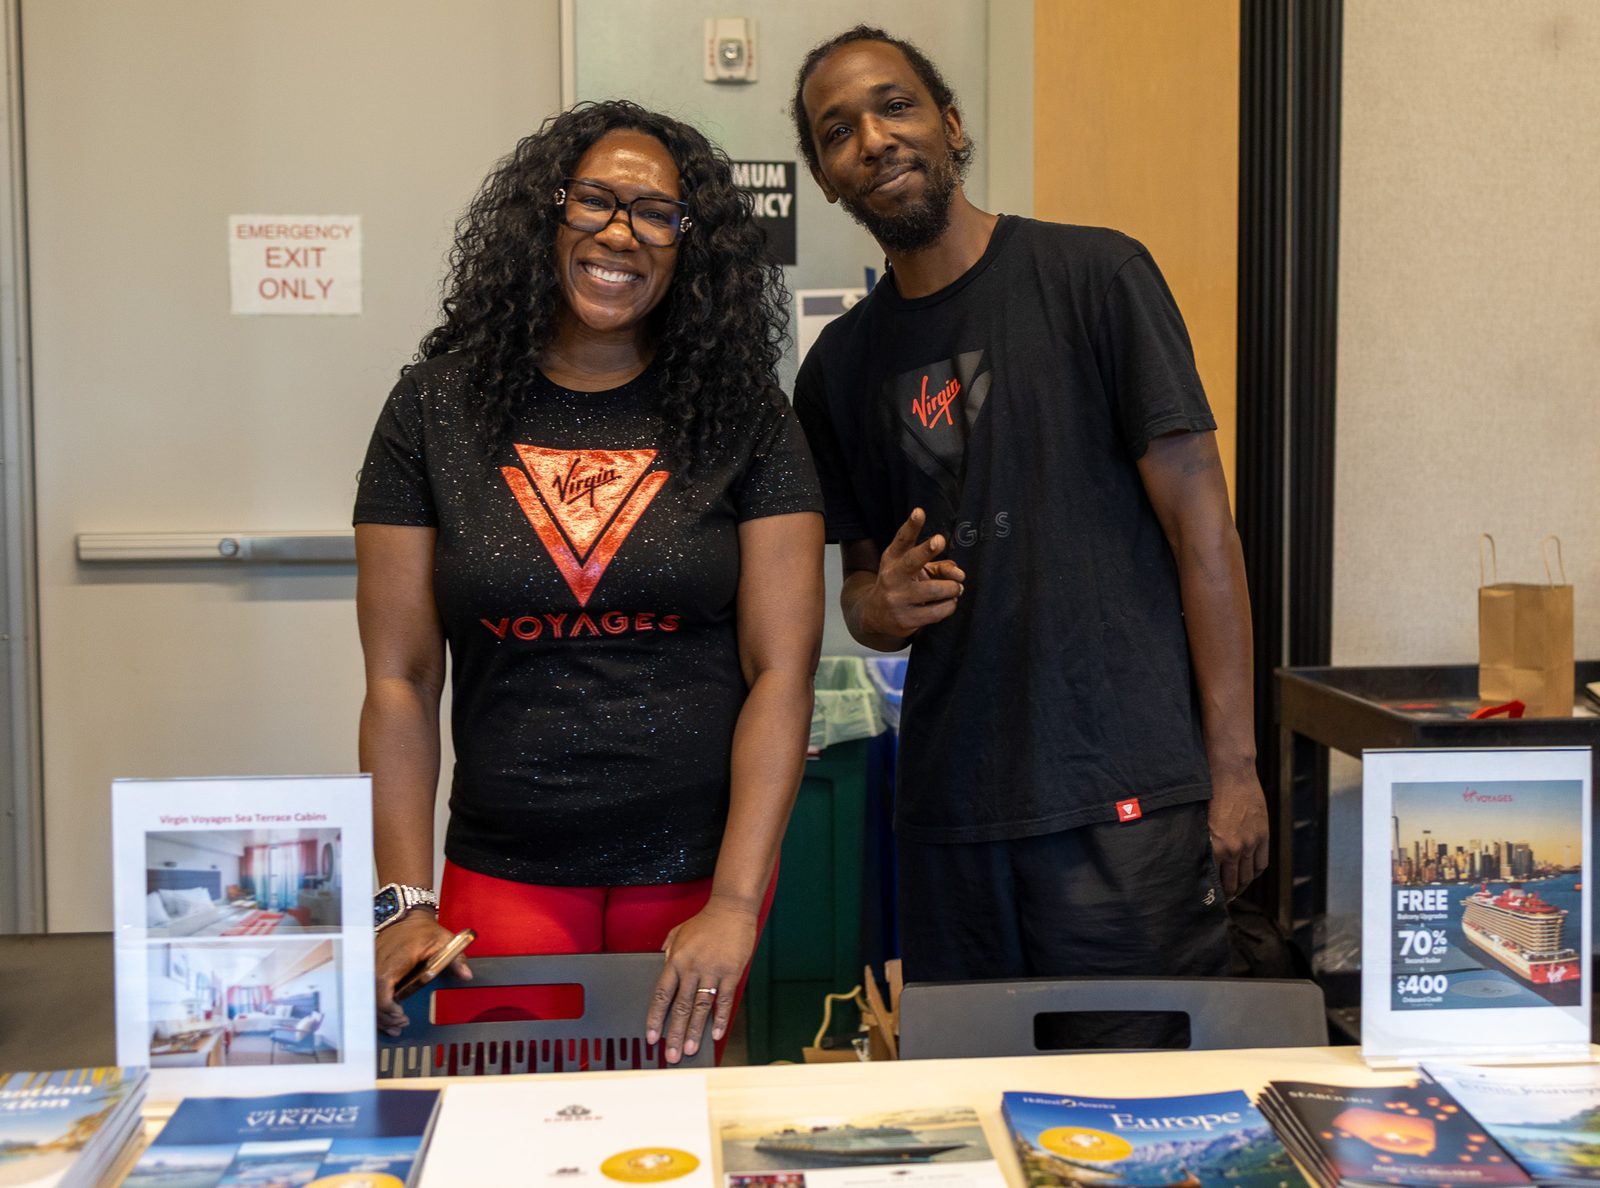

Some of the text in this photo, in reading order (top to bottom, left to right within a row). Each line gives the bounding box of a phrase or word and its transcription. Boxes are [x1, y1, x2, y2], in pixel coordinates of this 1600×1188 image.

[236, 223, 353, 240] EMERGENCY
[266, 246, 326, 268] EXIT
[259, 278, 334, 300] ONLY
[912, 375, 961, 429] Virgin
[552, 457, 622, 508] Virgin
[480, 611, 681, 640] VOYAGES
[1477, 794, 1513, 803] VOYAGES
[159, 812, 327, 826] Virgin Voyages Sea Terrace Cabins
[1397, 889, 1448, 911] FREE
[1432, 946, 1447, 954] OFF
[1397, 974, 1448, 995] $400
[1023, 1097, 1116, 1110] Holland America
[247, 1112, 358, 1127] VIKING
[1110, 1111, 1242, 1131] Europe
